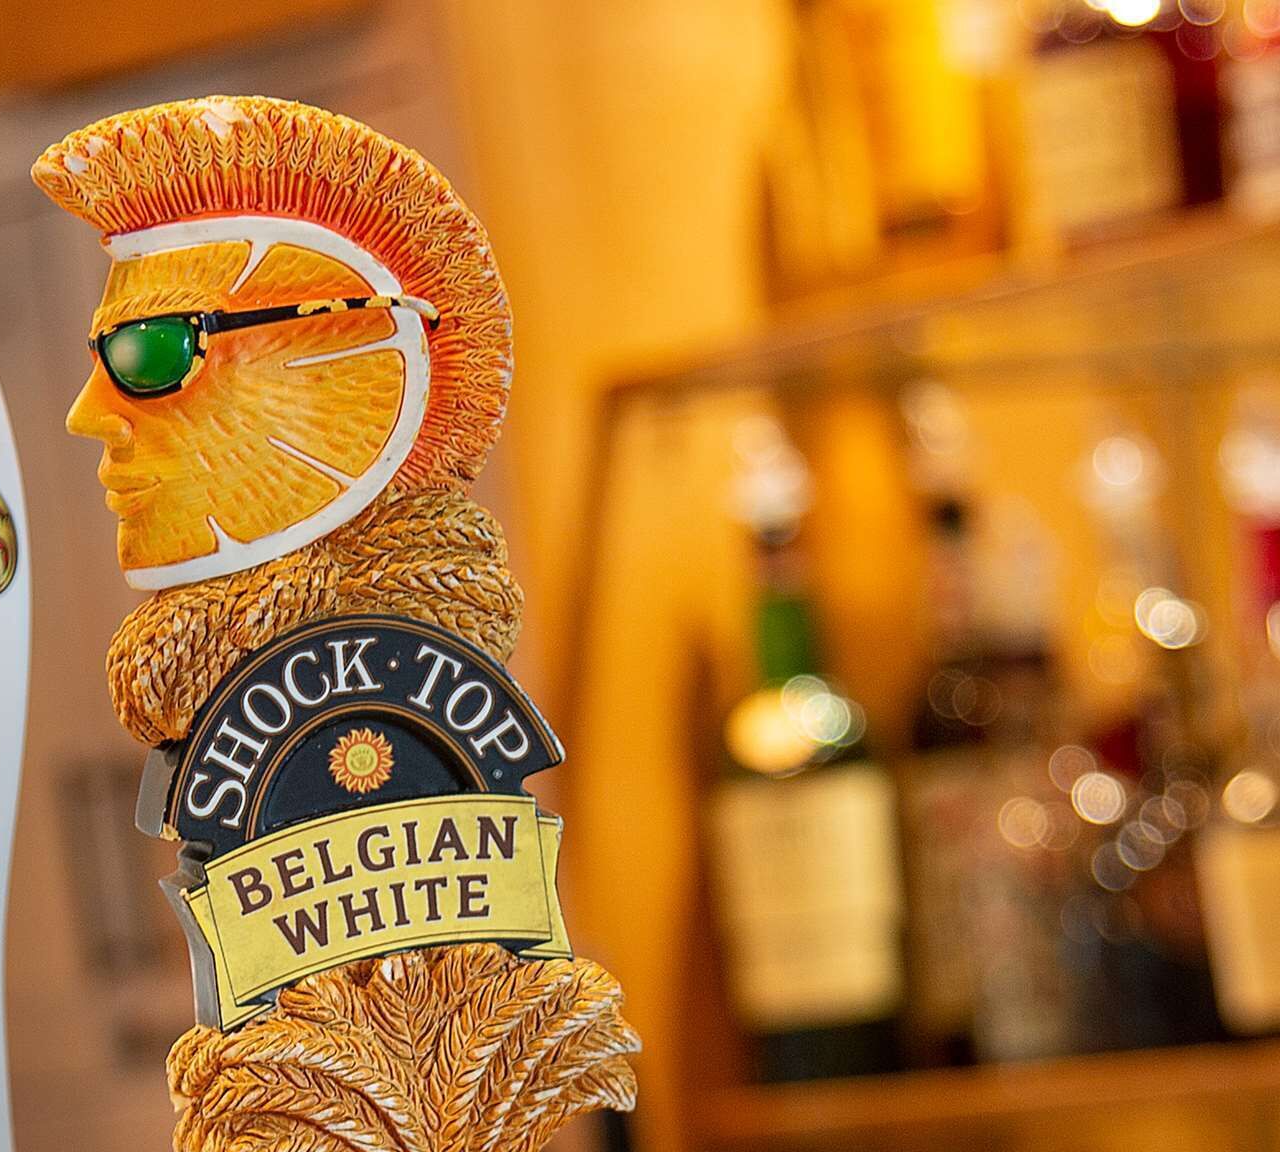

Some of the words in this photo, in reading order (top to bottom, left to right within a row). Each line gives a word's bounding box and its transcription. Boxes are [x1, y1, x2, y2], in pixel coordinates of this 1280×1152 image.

[187, 638, 381, 825] SHOCK
[408, 644, 530, 760] TOP
[228, 816, 518, 916] BELGIAN
[273, 874, 490, 955] WHITE
